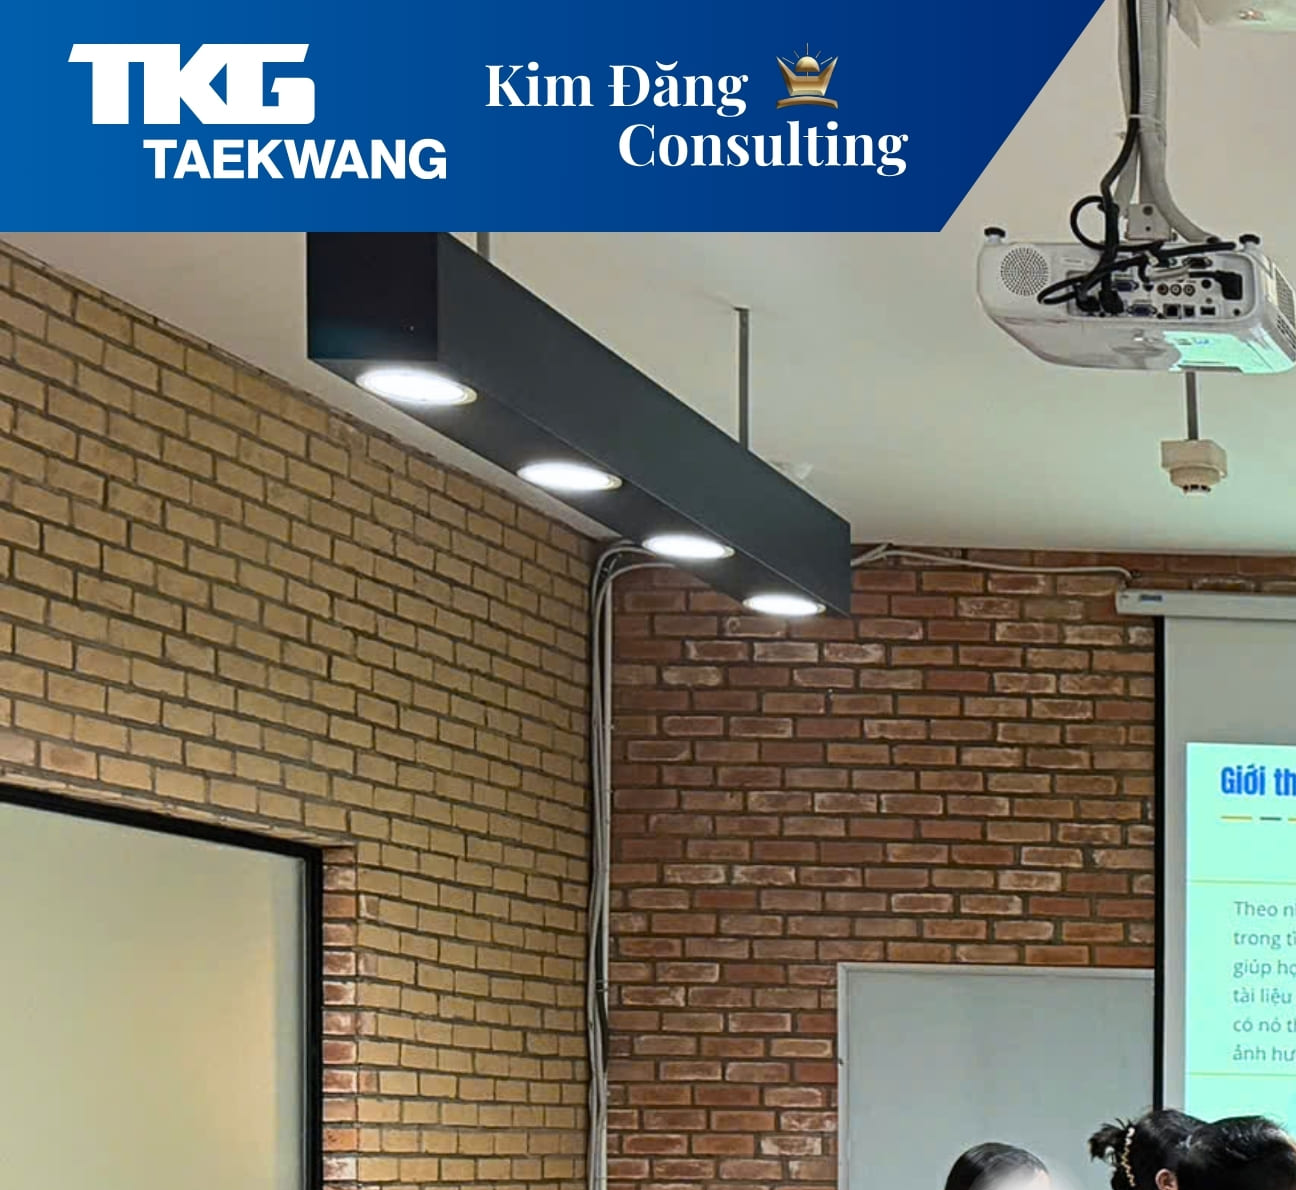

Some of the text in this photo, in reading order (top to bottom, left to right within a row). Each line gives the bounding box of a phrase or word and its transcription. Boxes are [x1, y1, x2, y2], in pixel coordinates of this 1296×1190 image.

[1220, 764, 1266, 795] Giới
[1233, 901, 1278, 917] Theo
[1233, 932, 1281, 950] trong
[1233, 959, 1272, 979] giúp
[1233, 987, 1255, 1003] tài
[1260, 988, 1293, 1006] liệu
[1233, 1016, 1254, 1033] có
[1259, 1017, 1282, 1033] nó
[1232, 1044, 1266, 1061] ảnh
